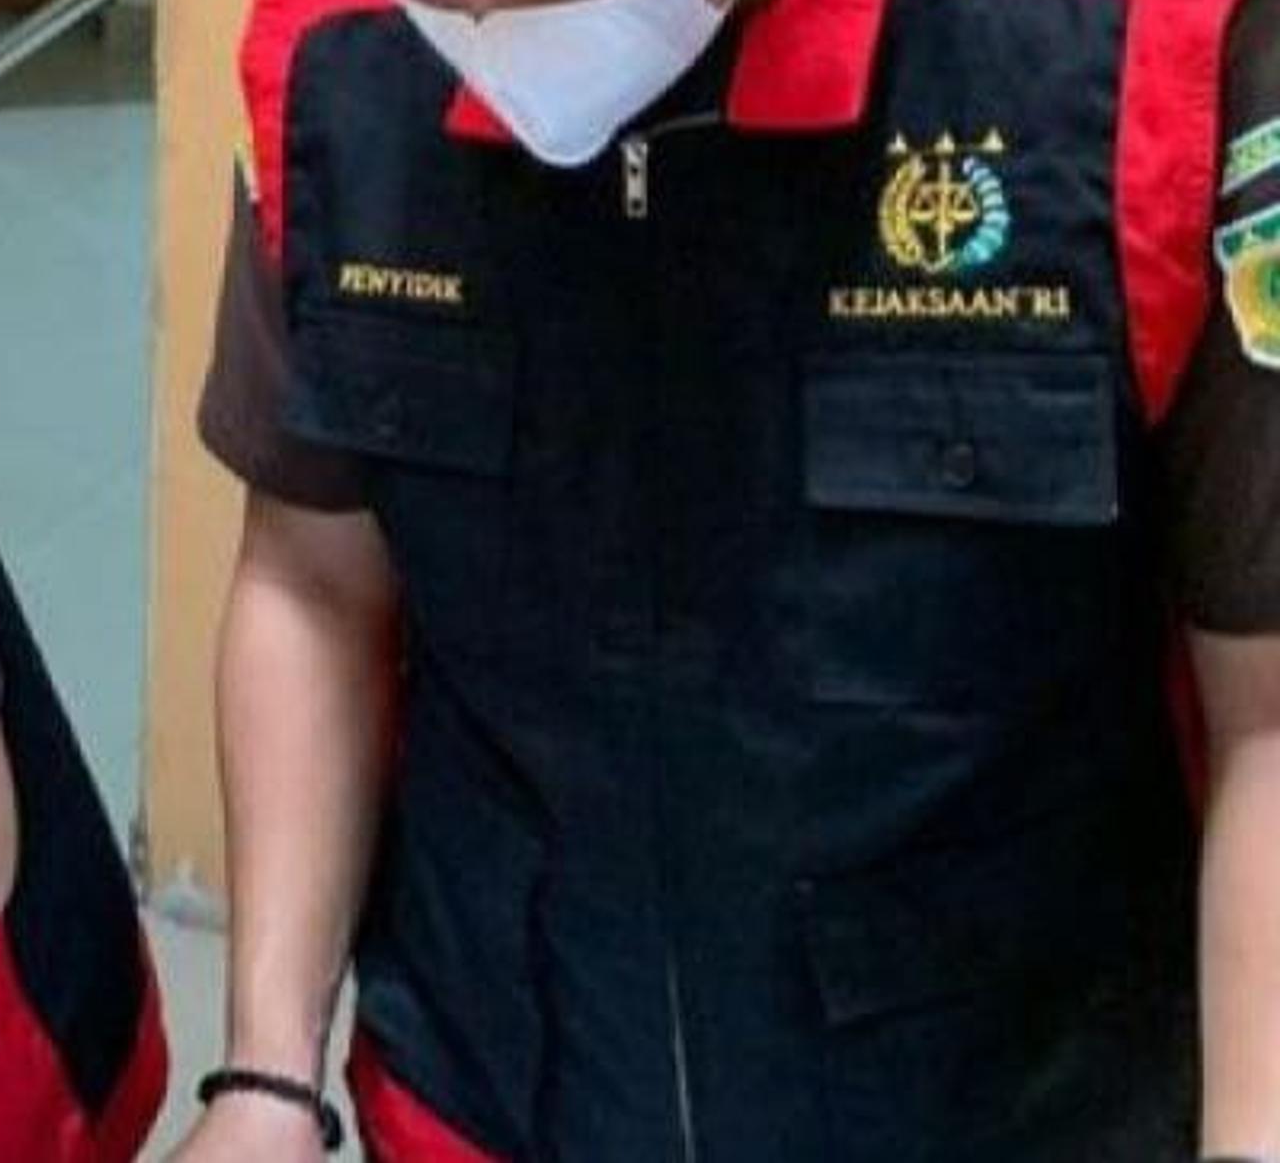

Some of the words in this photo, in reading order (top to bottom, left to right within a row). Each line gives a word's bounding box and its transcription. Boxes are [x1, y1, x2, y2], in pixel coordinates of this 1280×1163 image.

[340, 262, 462, 304] PENYIDIK
[828, 287, 1017, 318] KEJAKSAAN
[1032, 287, 1070, 319] RI
